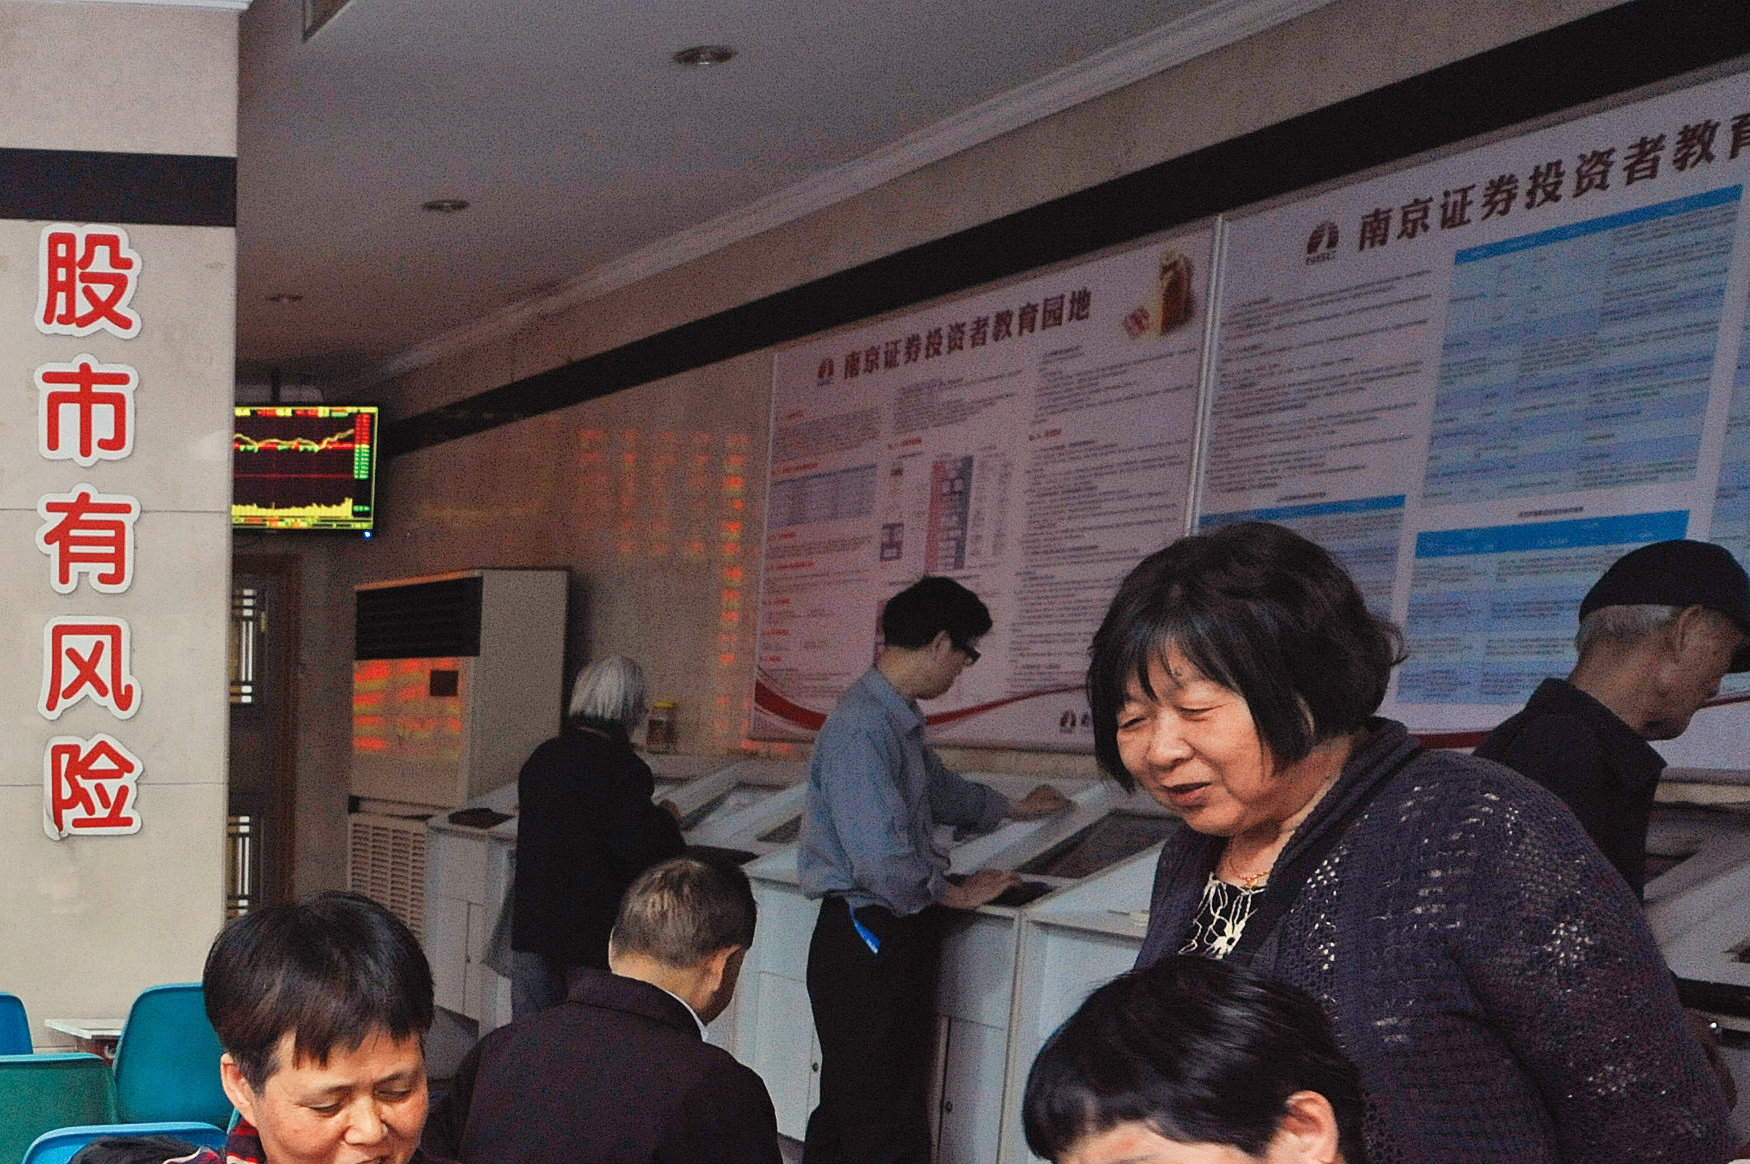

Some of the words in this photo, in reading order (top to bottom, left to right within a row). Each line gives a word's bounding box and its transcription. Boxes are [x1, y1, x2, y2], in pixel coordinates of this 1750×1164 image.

[840, 286, 1094, 381] 南京证券投资者教育园地
[40, 230, 136, 834] 股市有风险
